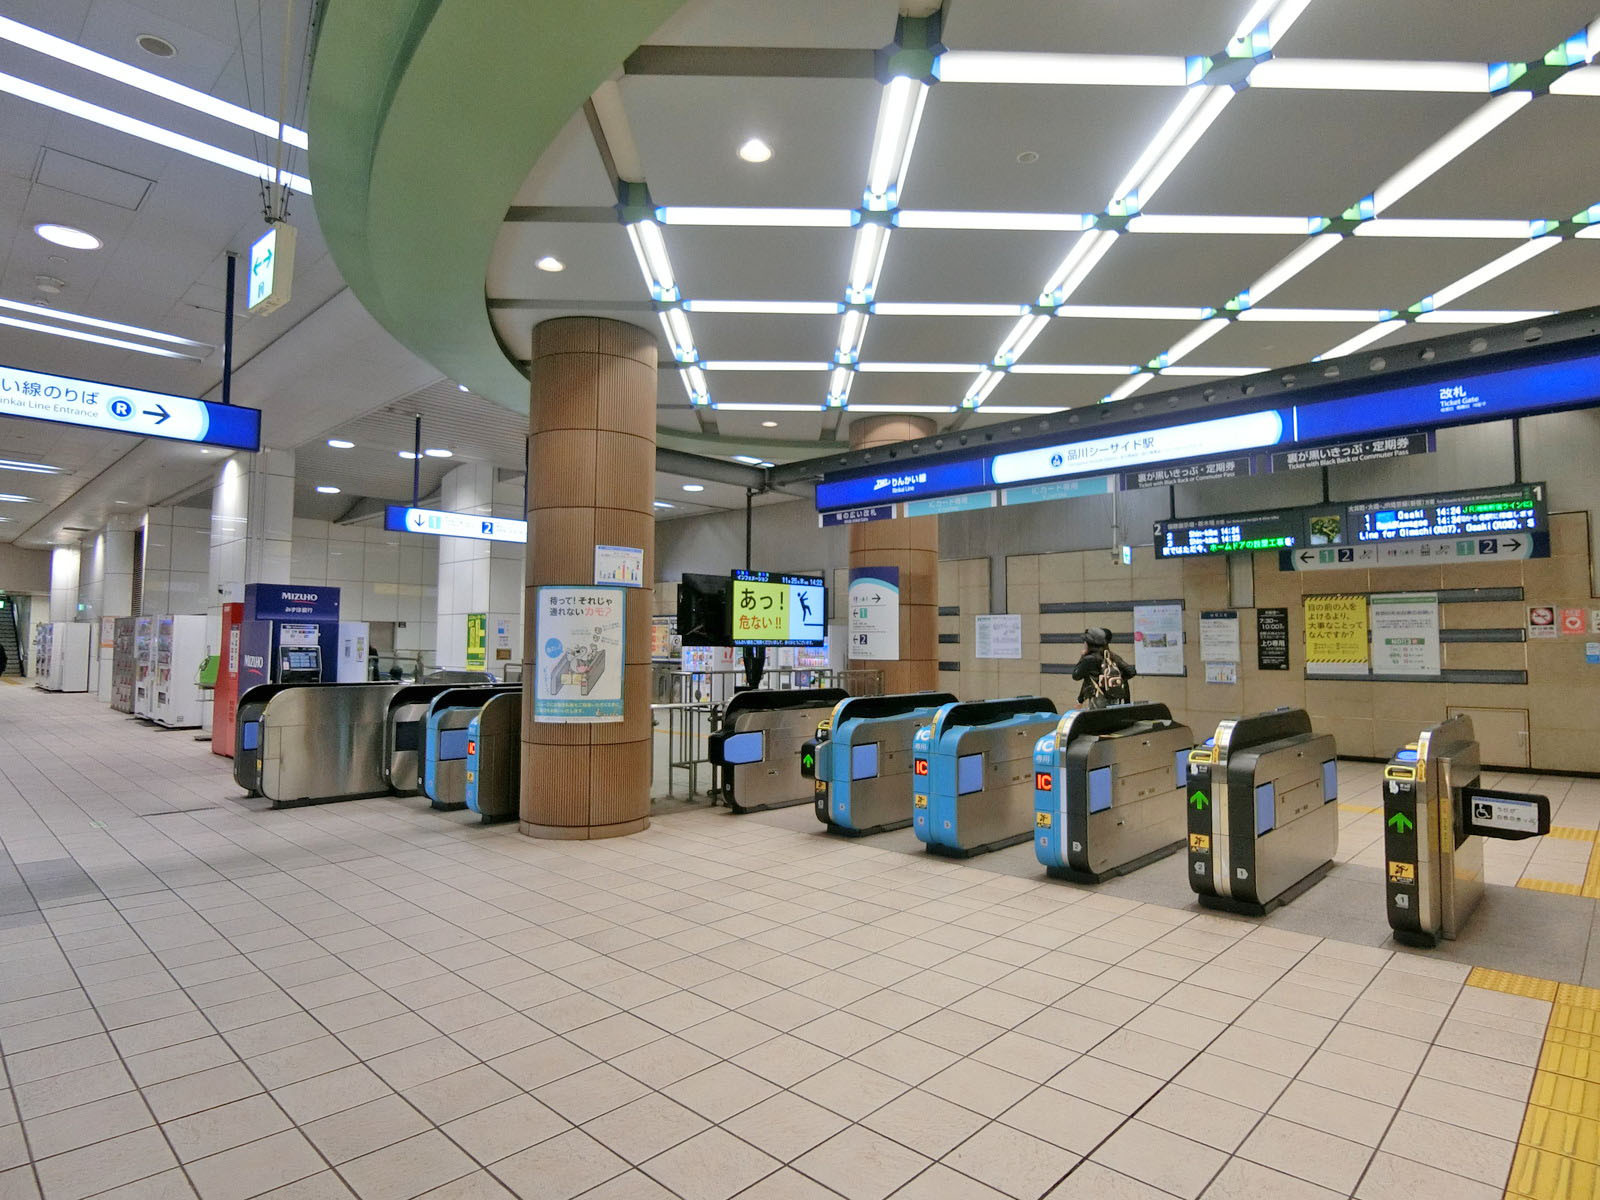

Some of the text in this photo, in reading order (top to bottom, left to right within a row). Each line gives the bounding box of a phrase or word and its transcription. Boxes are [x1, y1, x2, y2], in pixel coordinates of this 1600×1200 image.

[1, 378, 100, 405] い線のりば
[1439, 385, 1467, 399] 改札
[1440, 398, 1461, 407] Ticket
[1461, 396, 1480, 404] Gate
[28, 400, 51, 411] Line
[53, 403, 99, 418] Entrance
[115, 402, 128, 415] R
[1067, 436, 1155, 462] 品川シーサイド駅
[1288, 462, 1306, 470] Ticket
[1359, 452, 1394, 461] Commuter
[1394, 449, 1409, 457] Pass
[891, 473, 927, 487] りんかい線
[1532, 485, 1542, 501] 1
[483, 522, 492, 534] 2
[1153, 523, 1162, 536] 2
[1484, 540, 1495, 553] 2
[1342, 549, 1351, 561] 2
[281, 592, 319, 602] MIZUHO
[578, 596, 613, 606] それじゃ
[1308, 603, 1357, 611] 目の前の人を
[1308, 621, 1363, 630] 大事なことって
[860, 635, 866, 645] 2
[244, 654, 264, 669] MIZUHO
[915, 729, 931, 741] IC
[1036, 740, 1055, 752] IC
[916, 760, 928, 775] IC
[1037, 774, 1052, 790] IC
